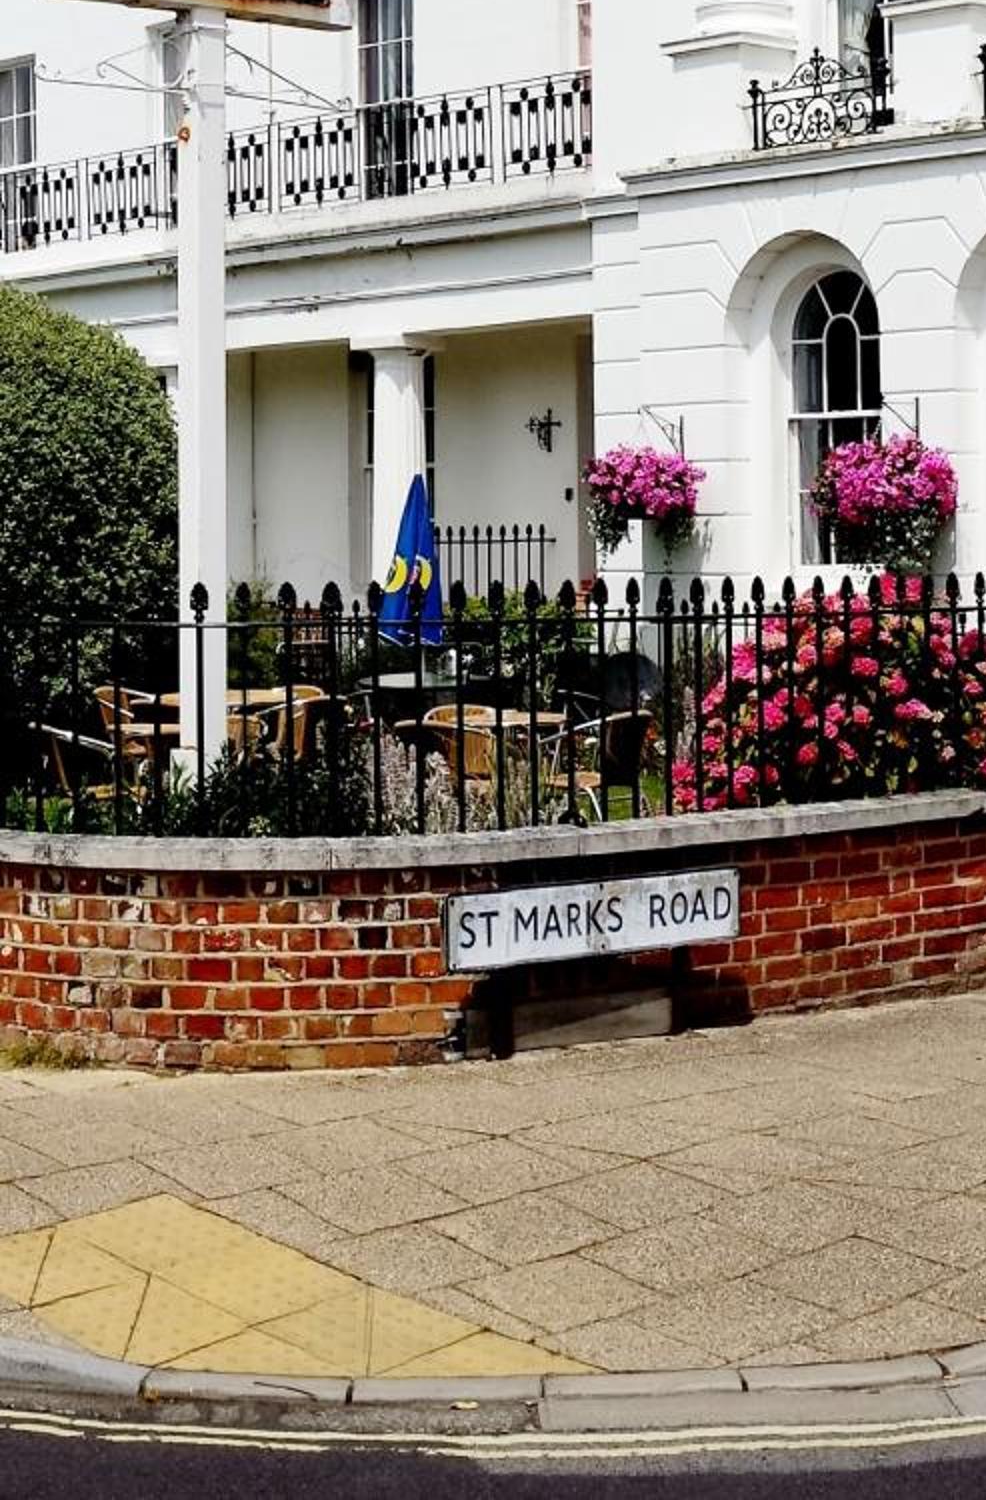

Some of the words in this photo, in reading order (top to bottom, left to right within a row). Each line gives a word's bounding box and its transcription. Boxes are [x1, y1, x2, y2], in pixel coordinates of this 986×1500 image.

[459, 911, 500, 950] ST
[513, 896, 624, 943] MARKS
[649, 886, 732, 929] ROAD
